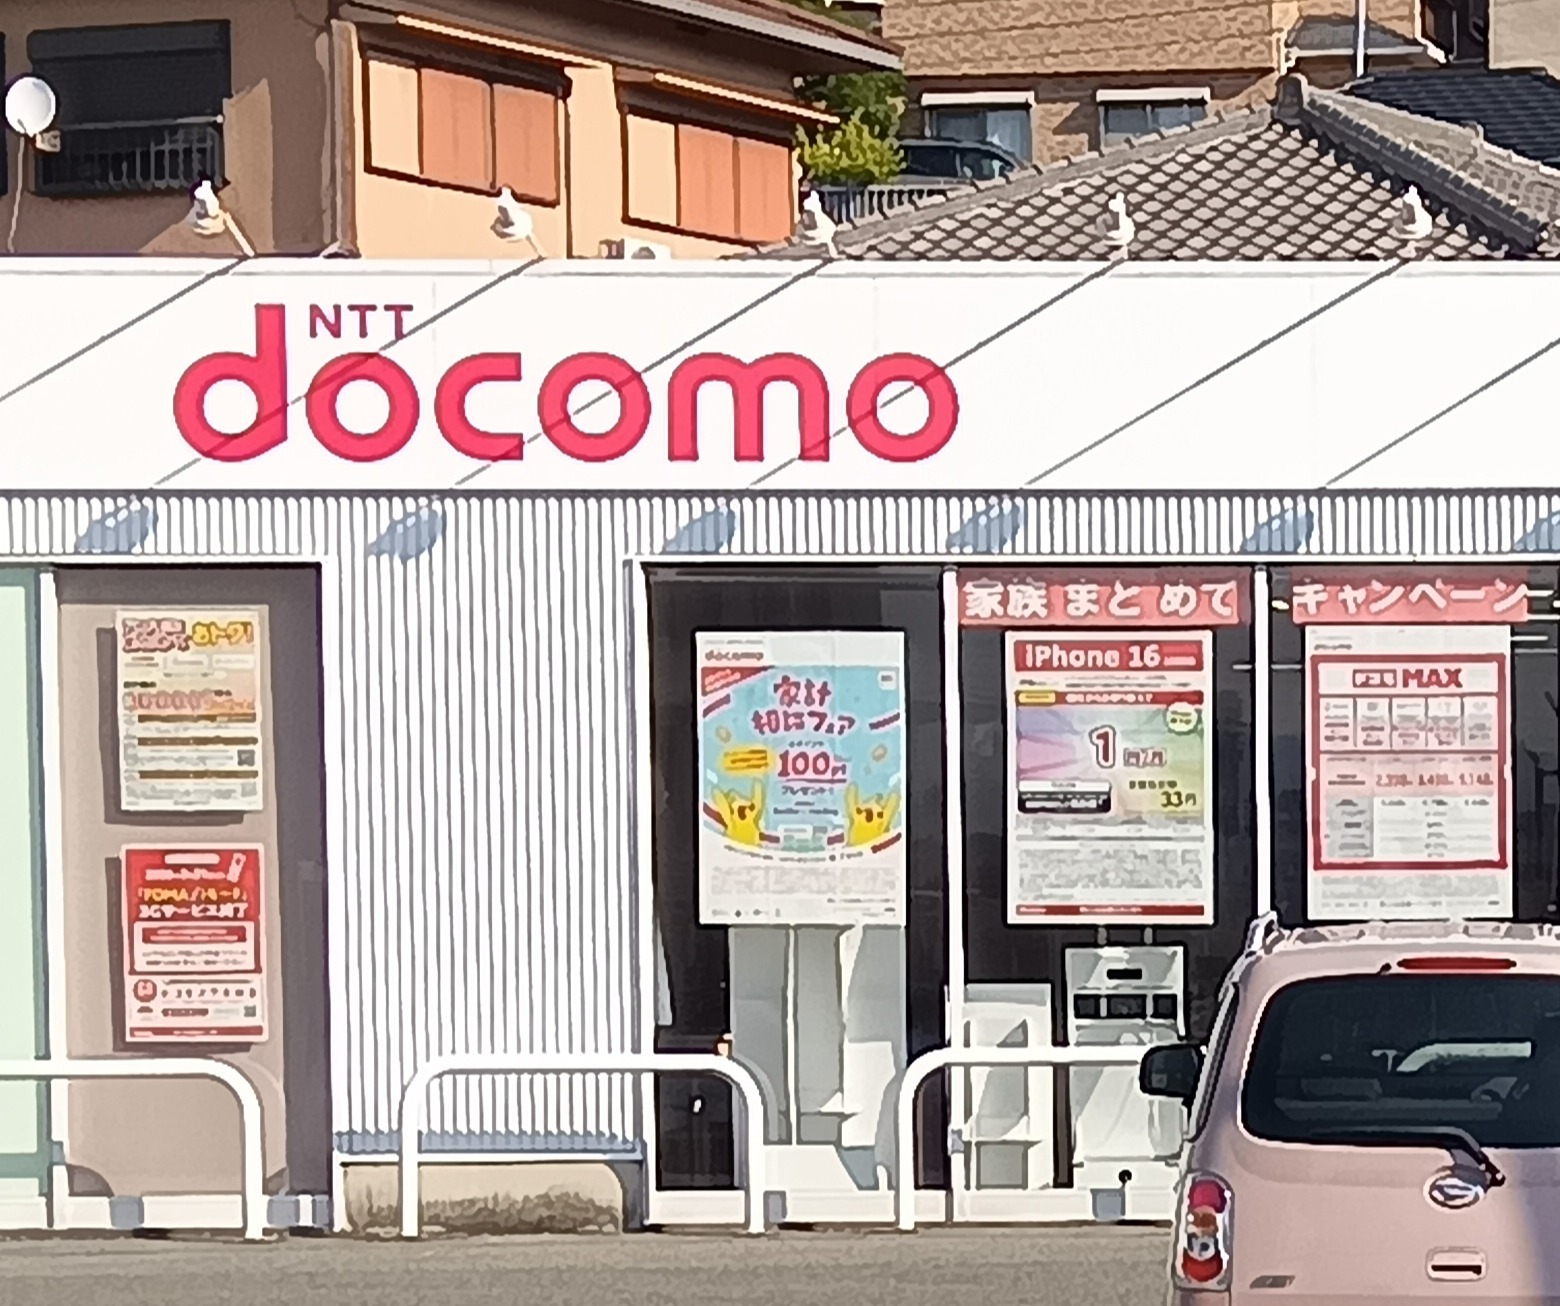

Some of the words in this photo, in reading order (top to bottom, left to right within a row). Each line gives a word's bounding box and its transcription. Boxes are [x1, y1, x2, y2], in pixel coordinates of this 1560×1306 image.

[309, 304, 414, 338] NTT
[173, 302, 959, 463] docomo
[1293, 578, 1528, 614] キャンペーン
[1025, 643, 1120, 669] iPhone
[1128, 643, 1161, 669] 16
[1402, 667, 1463, 688] MAX
